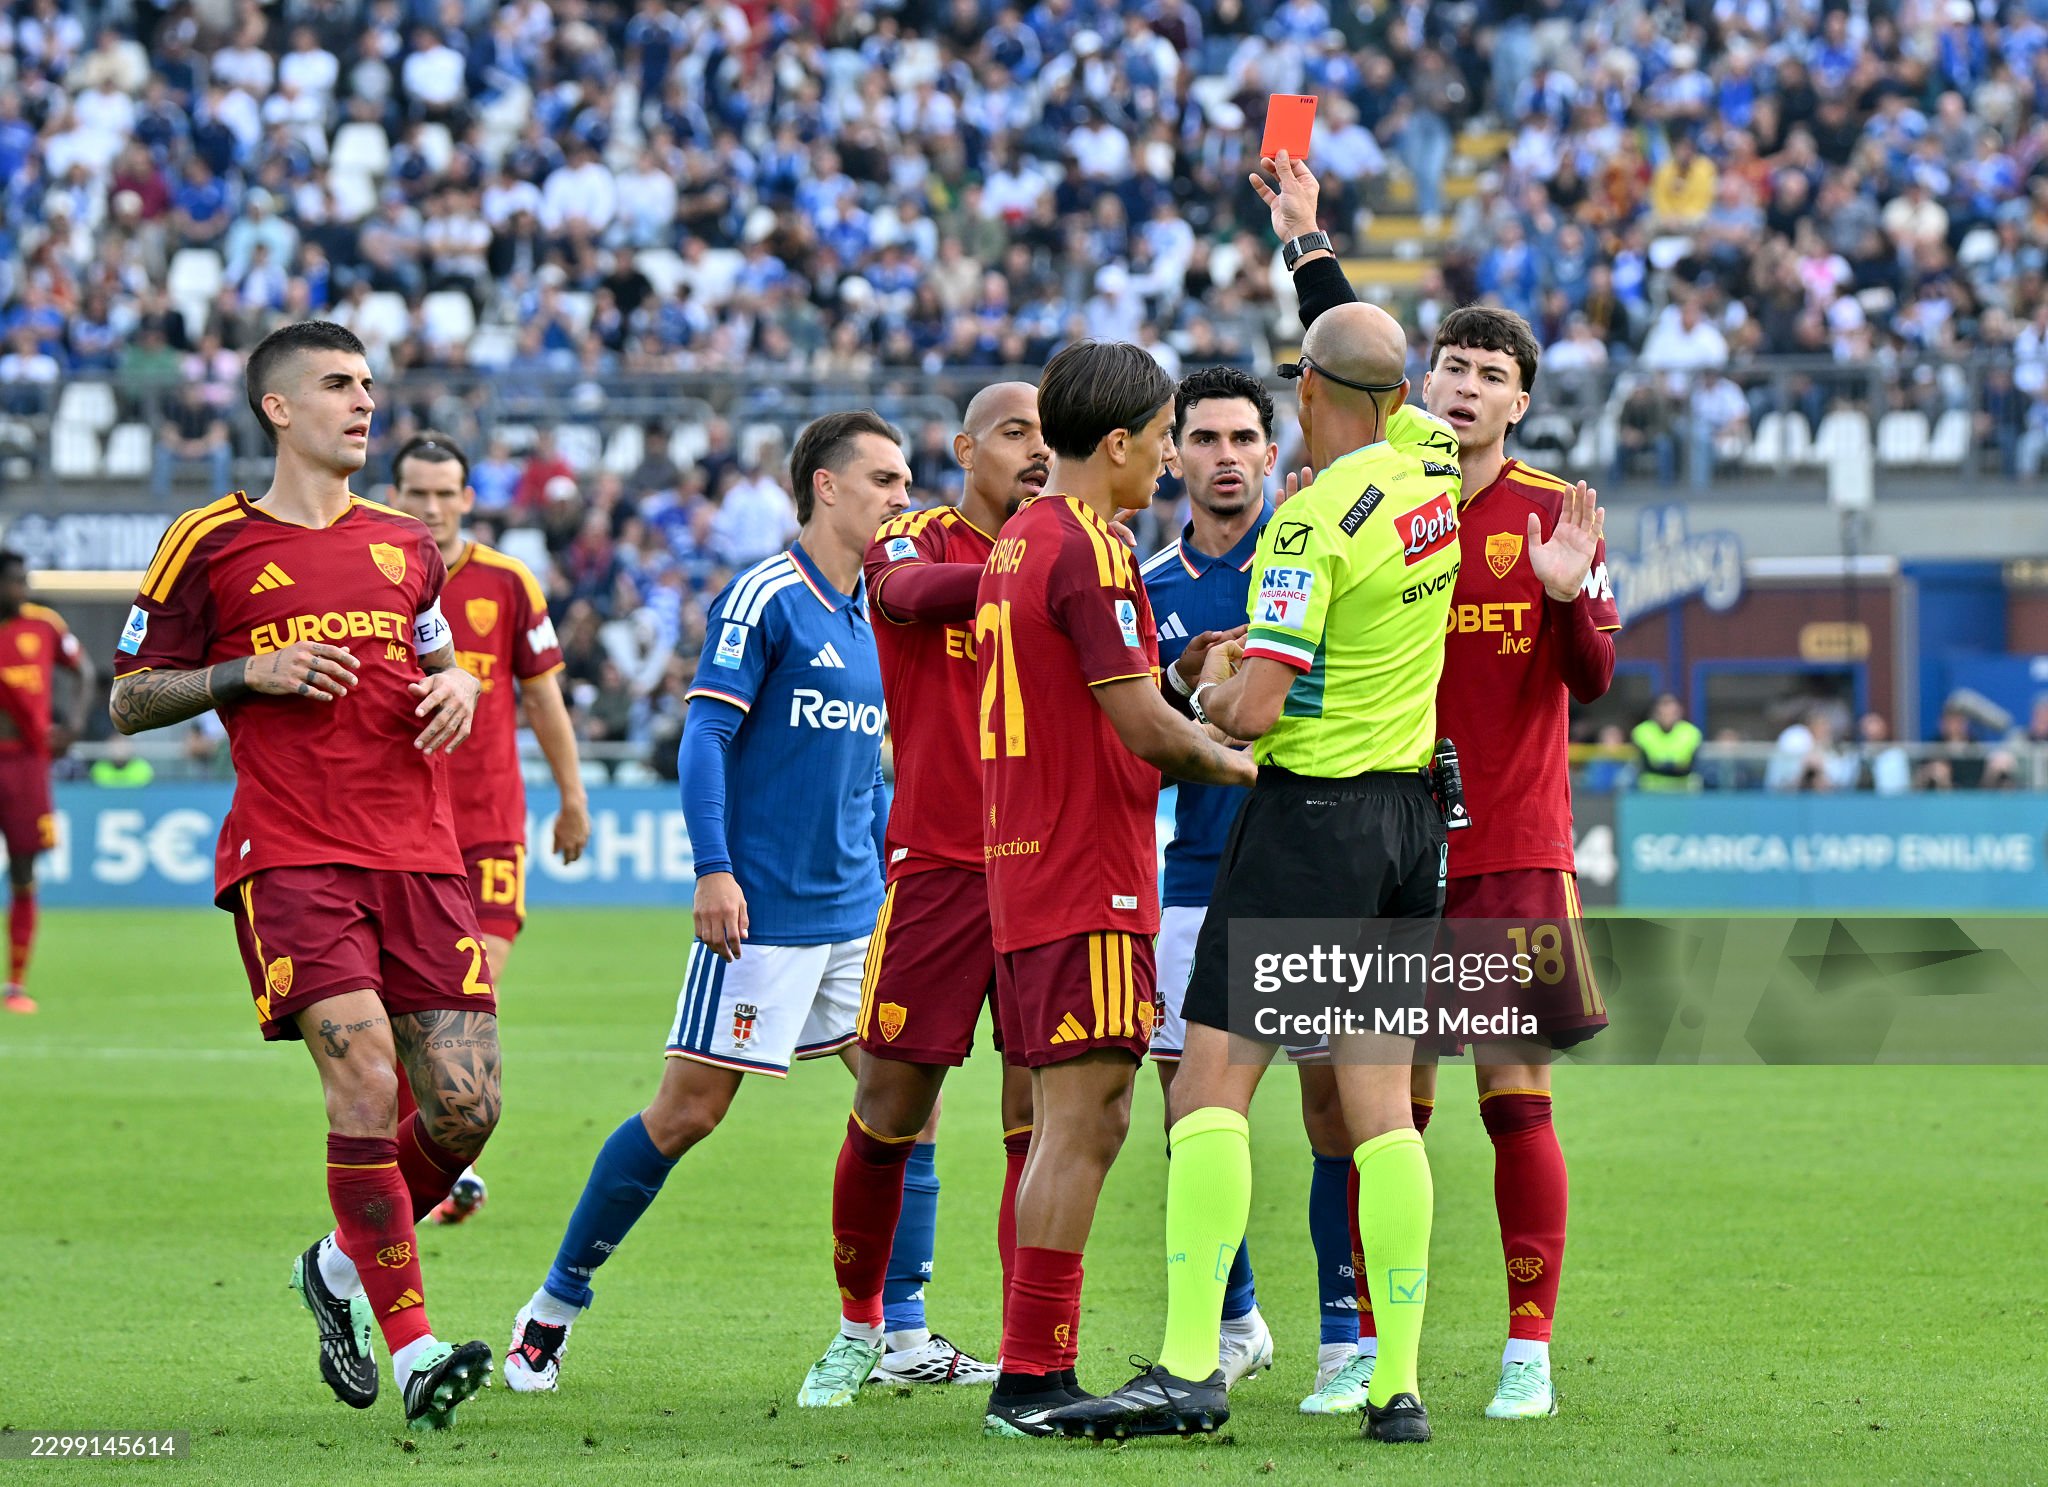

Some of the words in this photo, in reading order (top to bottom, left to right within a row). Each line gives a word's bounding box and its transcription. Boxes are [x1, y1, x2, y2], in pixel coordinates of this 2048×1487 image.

[1341, 508, 1363, 533] DAN
[1360, 485, 1381, 517] JOHN
[1404, 505, 1455, 557] Lete
[1260, 590, 1307, 602] INSURANCE
[1262, 569, 1312, 590] NET
[250, 610, 408, 656] EUROBET
[1497, 631, 1532, 655] .live
[976, 600, 1026, 760] 21
[91, 808, 214, 885] 5€
[1573, 824, 1618, 886] 4
[1633, 832, 1790, 872] SCARICA
[477, 857, 517, 905] 15
[455, 936, 495, 995] 2
[1507, 924, 1566, 989] 18
[591, 1240, 618, 1254] 190
